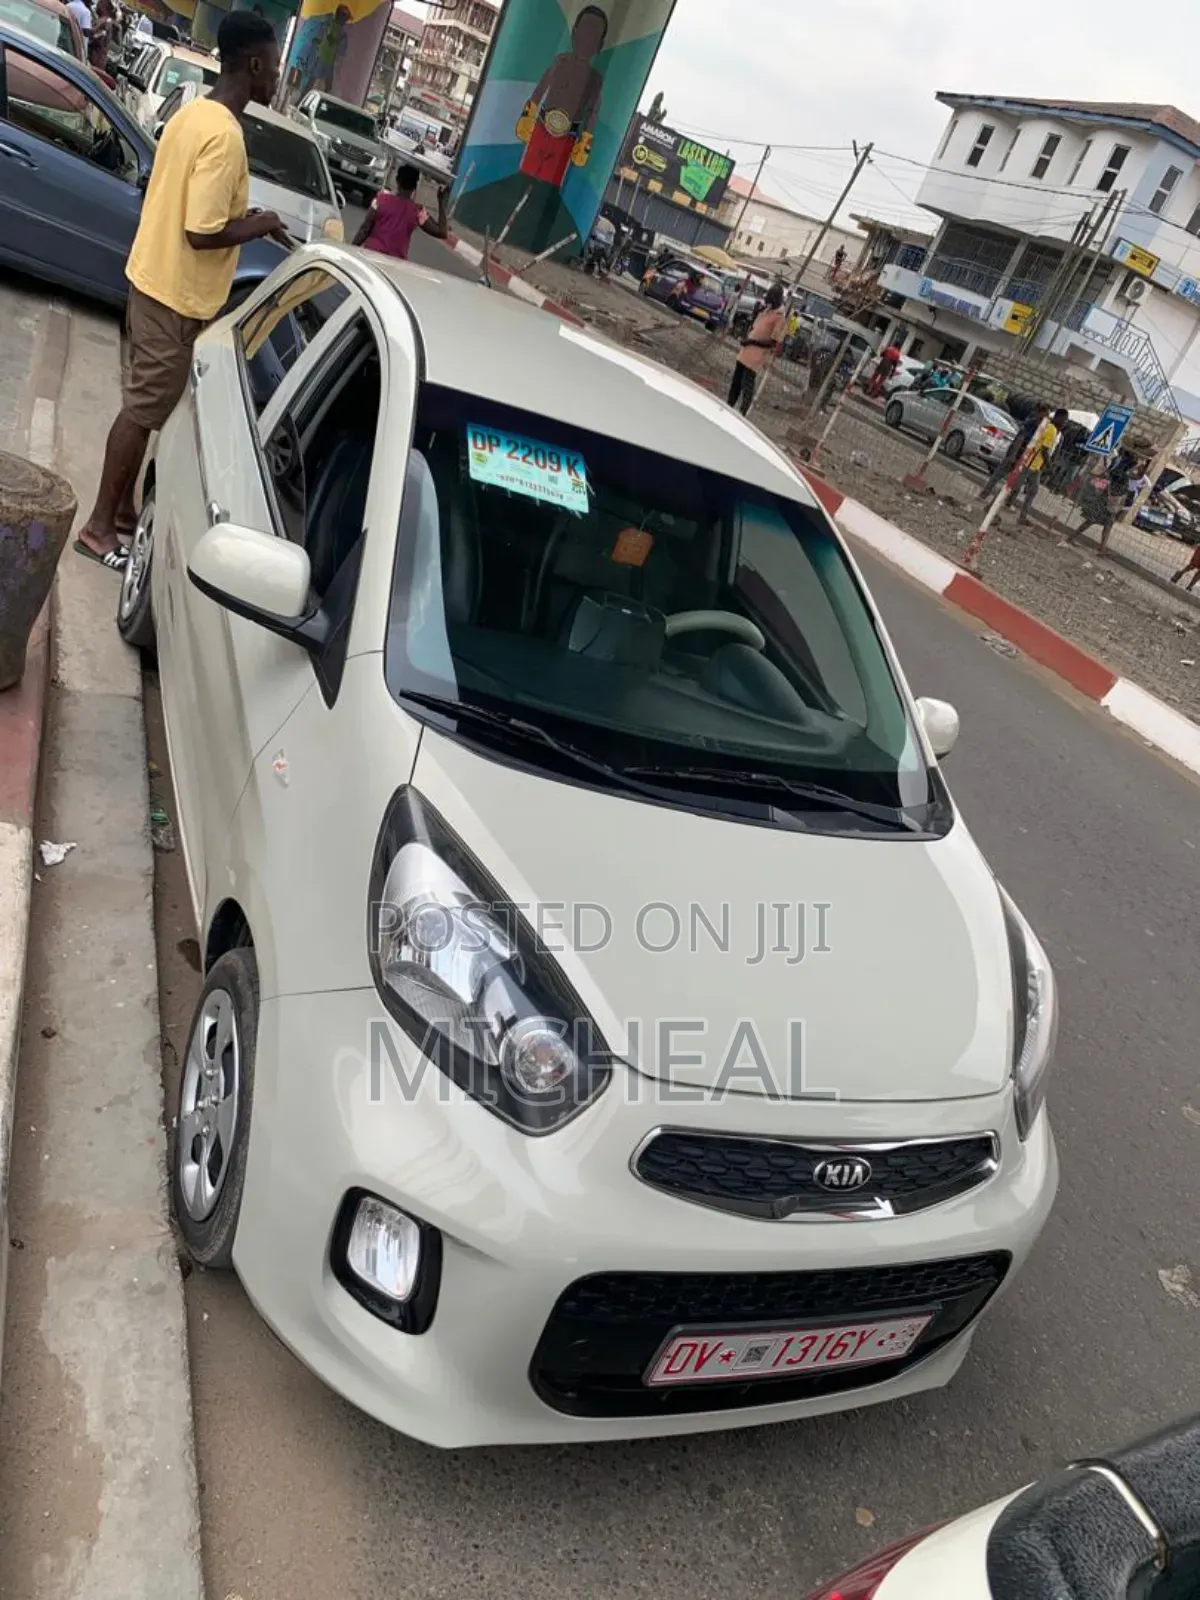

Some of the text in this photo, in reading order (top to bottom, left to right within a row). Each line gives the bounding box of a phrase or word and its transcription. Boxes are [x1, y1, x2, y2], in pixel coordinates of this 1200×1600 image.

[640, 122, 675, 145] AMARON
[472, 431, 500, 453] DP
[507, 440, 562, 473] 2209
[566, 453, 582, 479] K
[824, 1163, 864, 1186] KIA
[662, 1340, 723, 1376] DV
[771, 1328, 878, 1368] 1316Y
